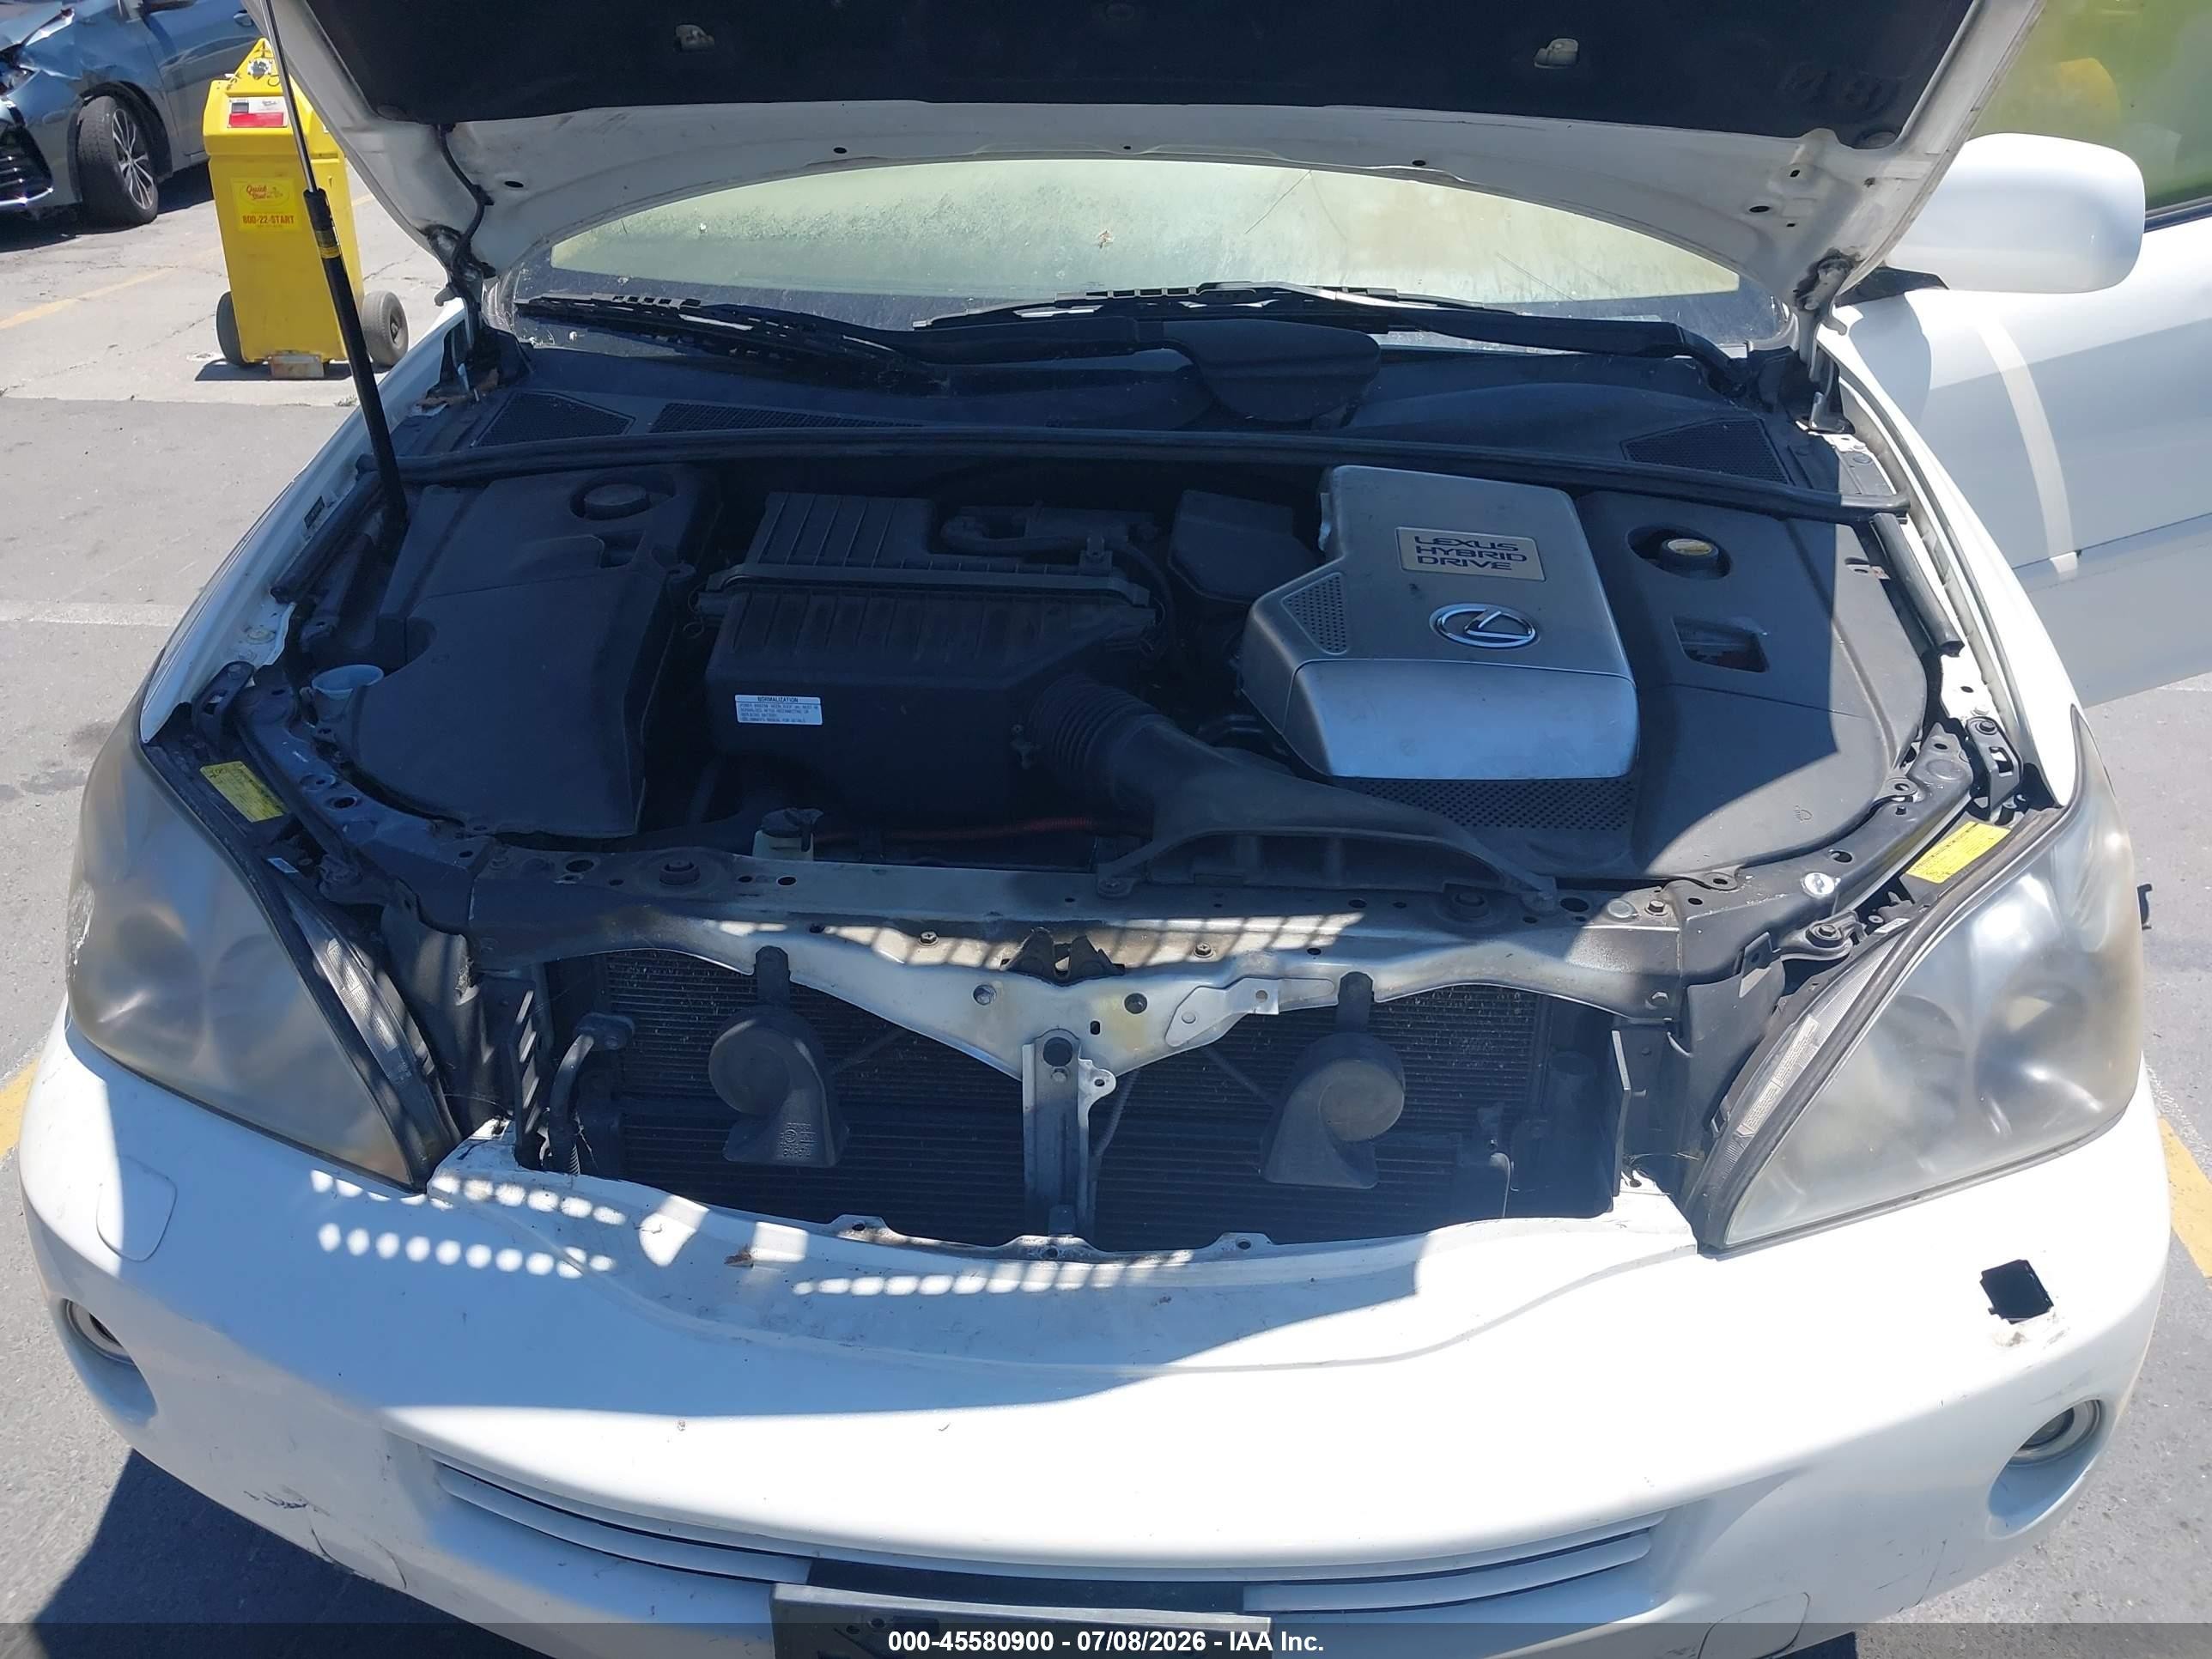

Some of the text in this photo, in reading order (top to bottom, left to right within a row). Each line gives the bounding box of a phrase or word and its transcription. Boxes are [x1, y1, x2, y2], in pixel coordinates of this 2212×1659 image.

[242, 215, 295, 224] 800-22-START
[1414, 536, 1519, 551] LEXUS
[1416, 545, 1528, 562] HYBRID
[1418, 556, 1512, 571] DRIVE
